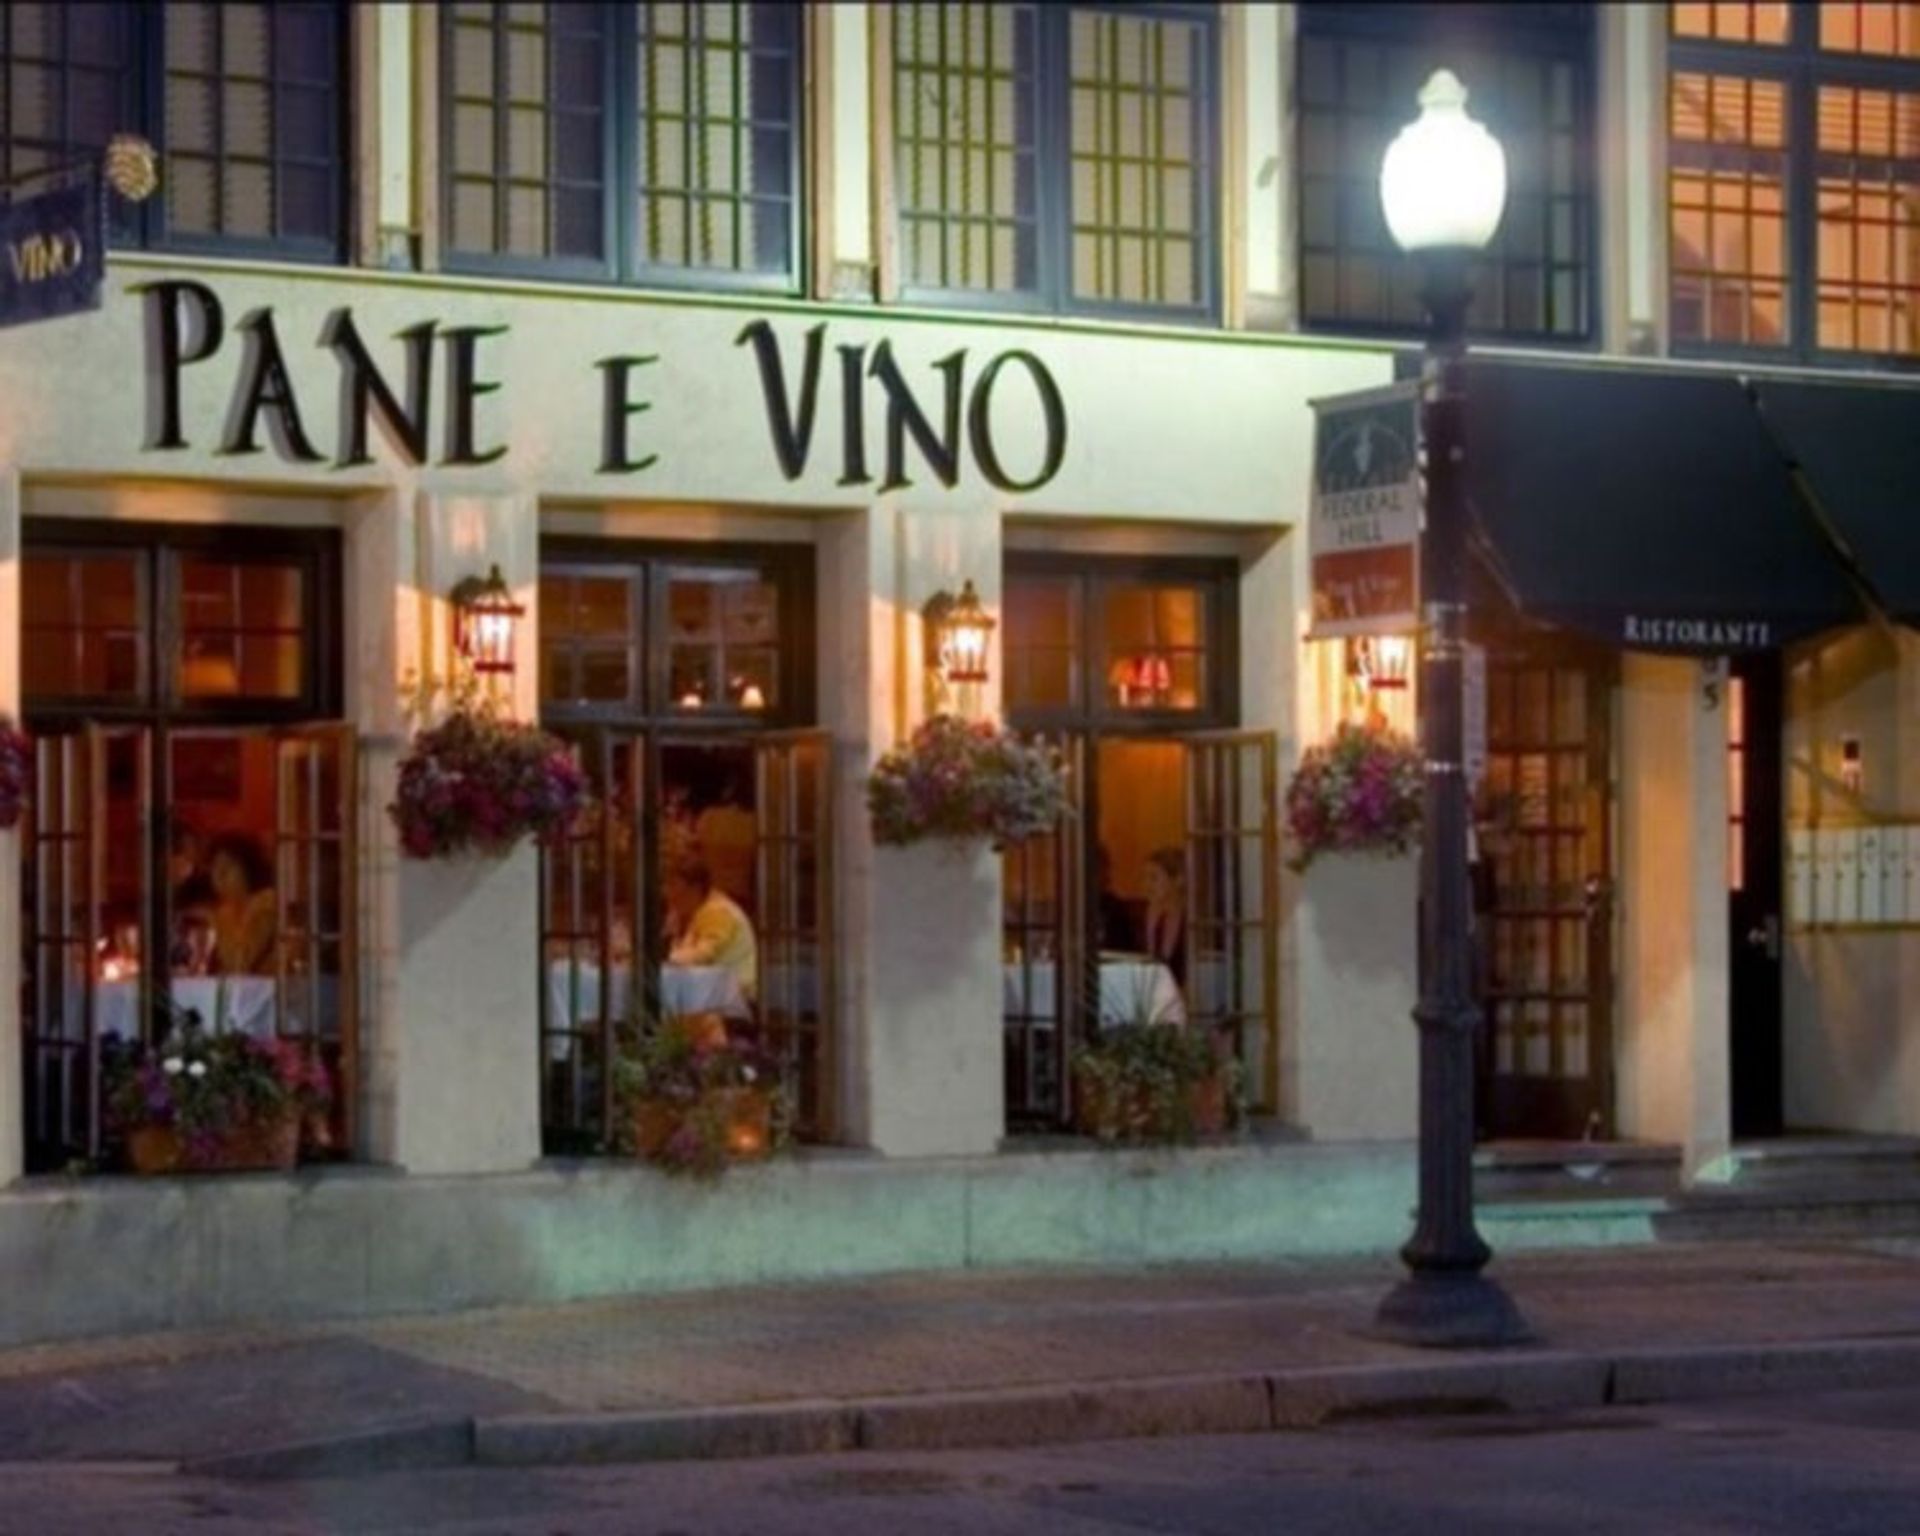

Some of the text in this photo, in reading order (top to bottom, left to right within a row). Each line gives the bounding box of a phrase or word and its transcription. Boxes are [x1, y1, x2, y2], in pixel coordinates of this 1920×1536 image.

[124, 279, 1067, 494] PANE E VINO
[1321, 489, 1404, 520] FEDERAL
